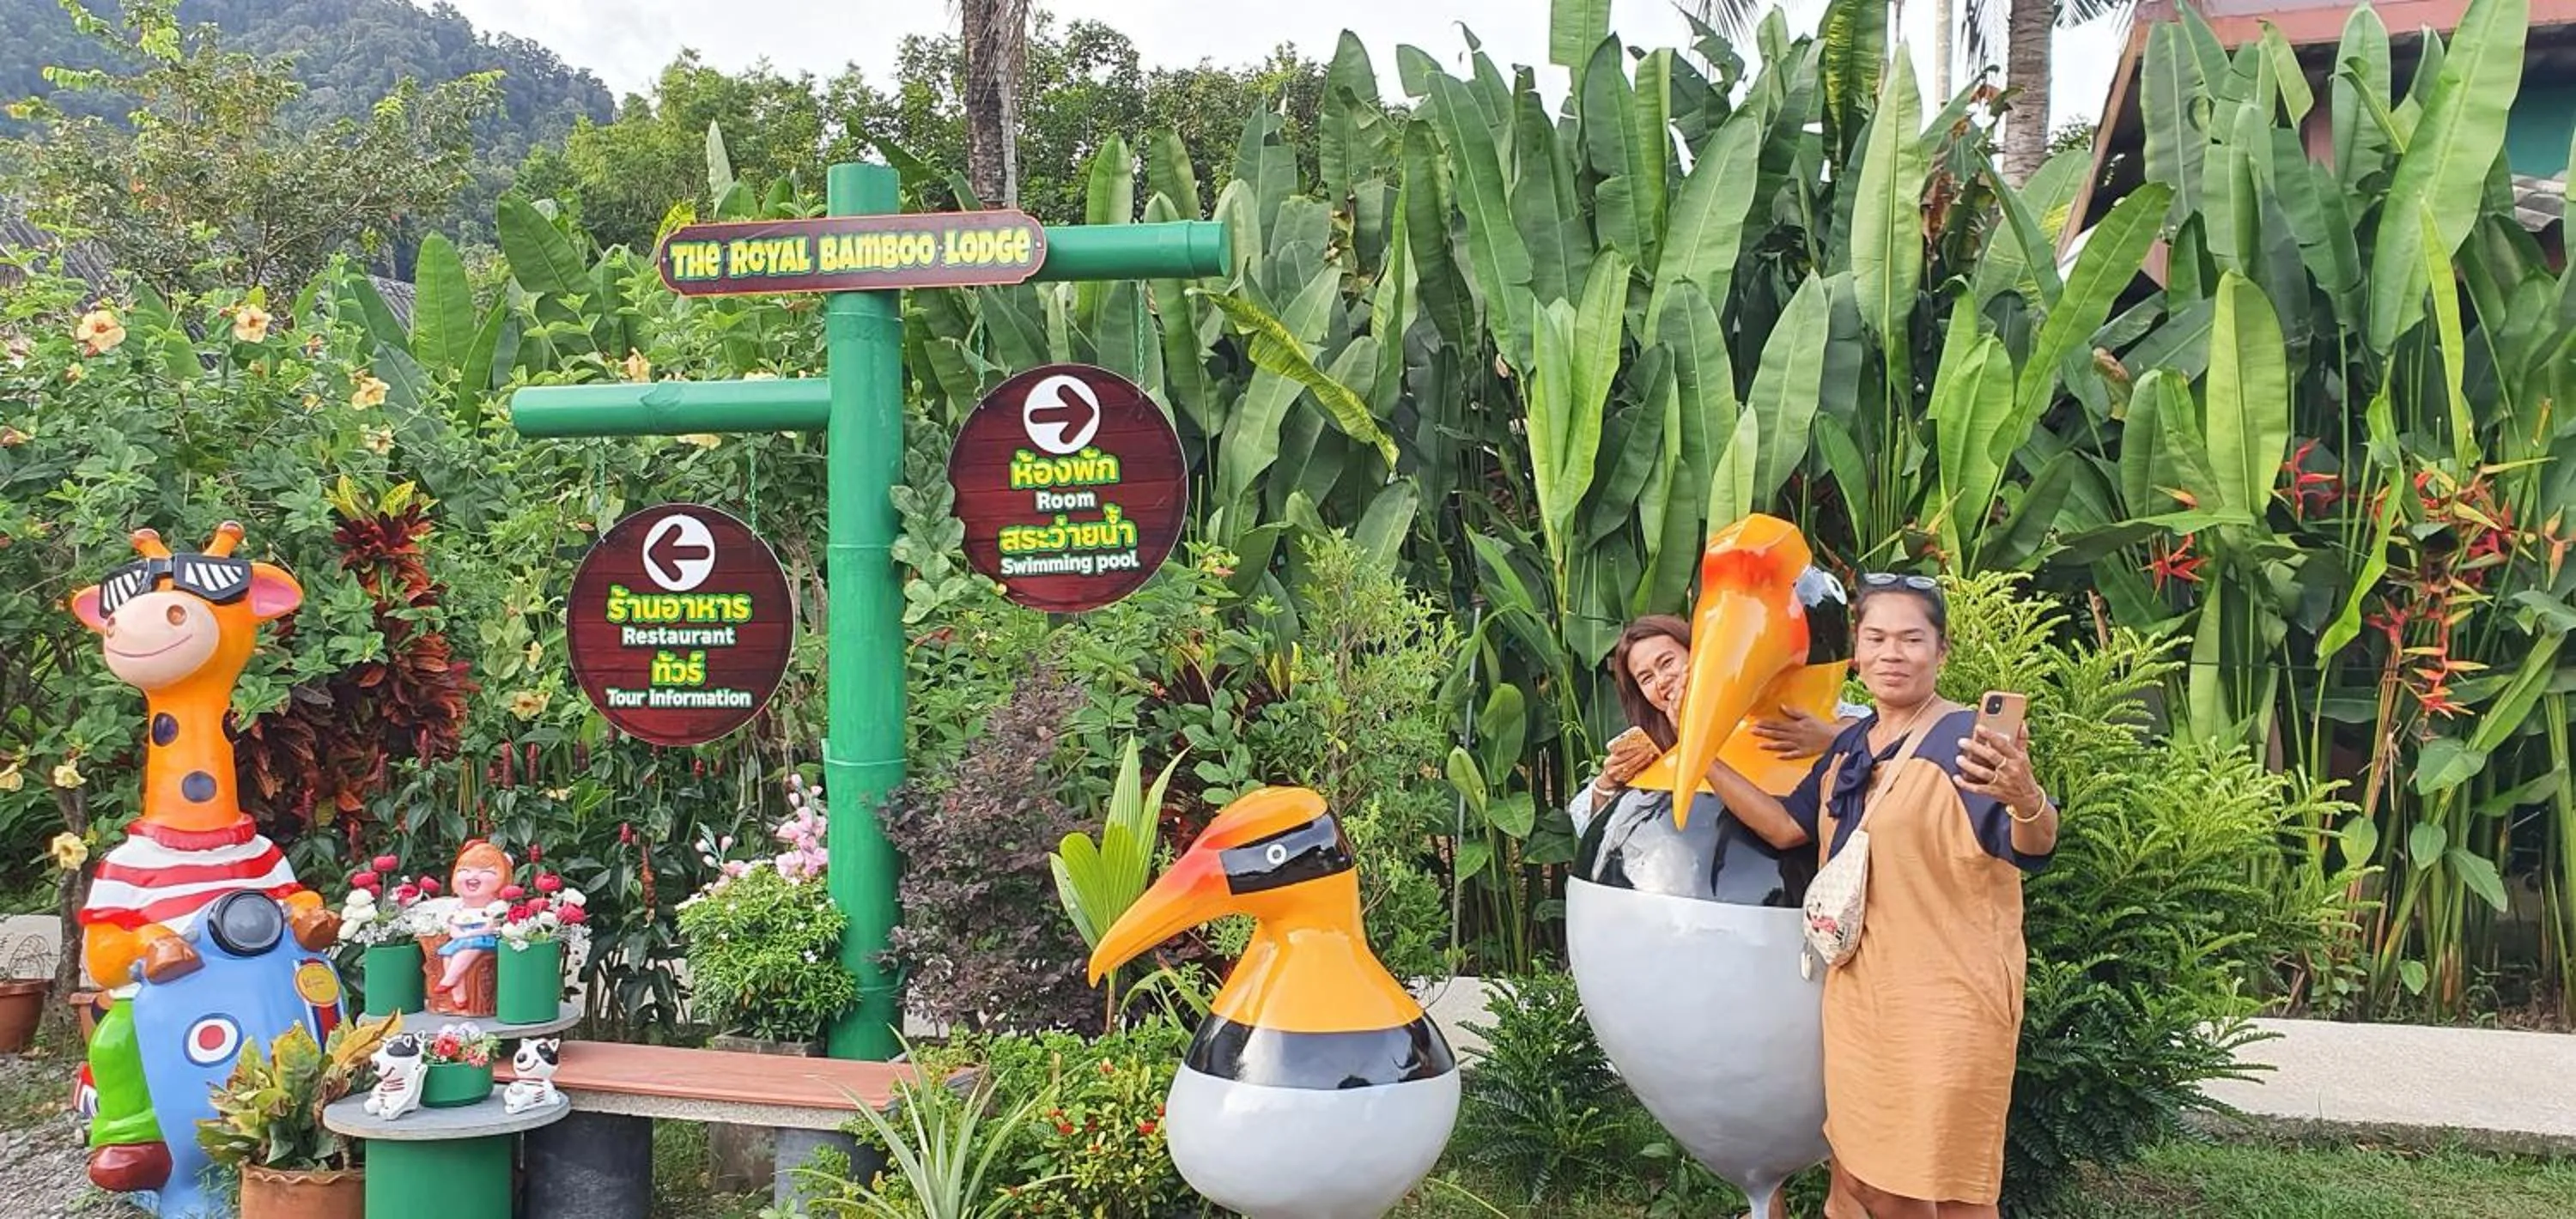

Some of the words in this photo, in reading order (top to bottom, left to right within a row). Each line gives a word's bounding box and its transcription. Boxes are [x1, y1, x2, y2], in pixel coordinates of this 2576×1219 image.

[729, 235, 811, 276] ROYAL
[819, 232, 936, 271] BAMBOO
[1011, 447, 1120, 488] ห้องพัก
[1036, 491, 1097, 510] Room
[999, 504, 1137, 553] สระว่ายน้ำ
[1001, 555, 1092, 574] Swimming
[1097, 551, 1139, 572] pool
[607, 585, 751, 622] ร้านอาหาร
[622, 627, 736, 646] Restaurant
[651, 650, 707, 685] ทัวร์
[605, 688, 644, 706] Tour
